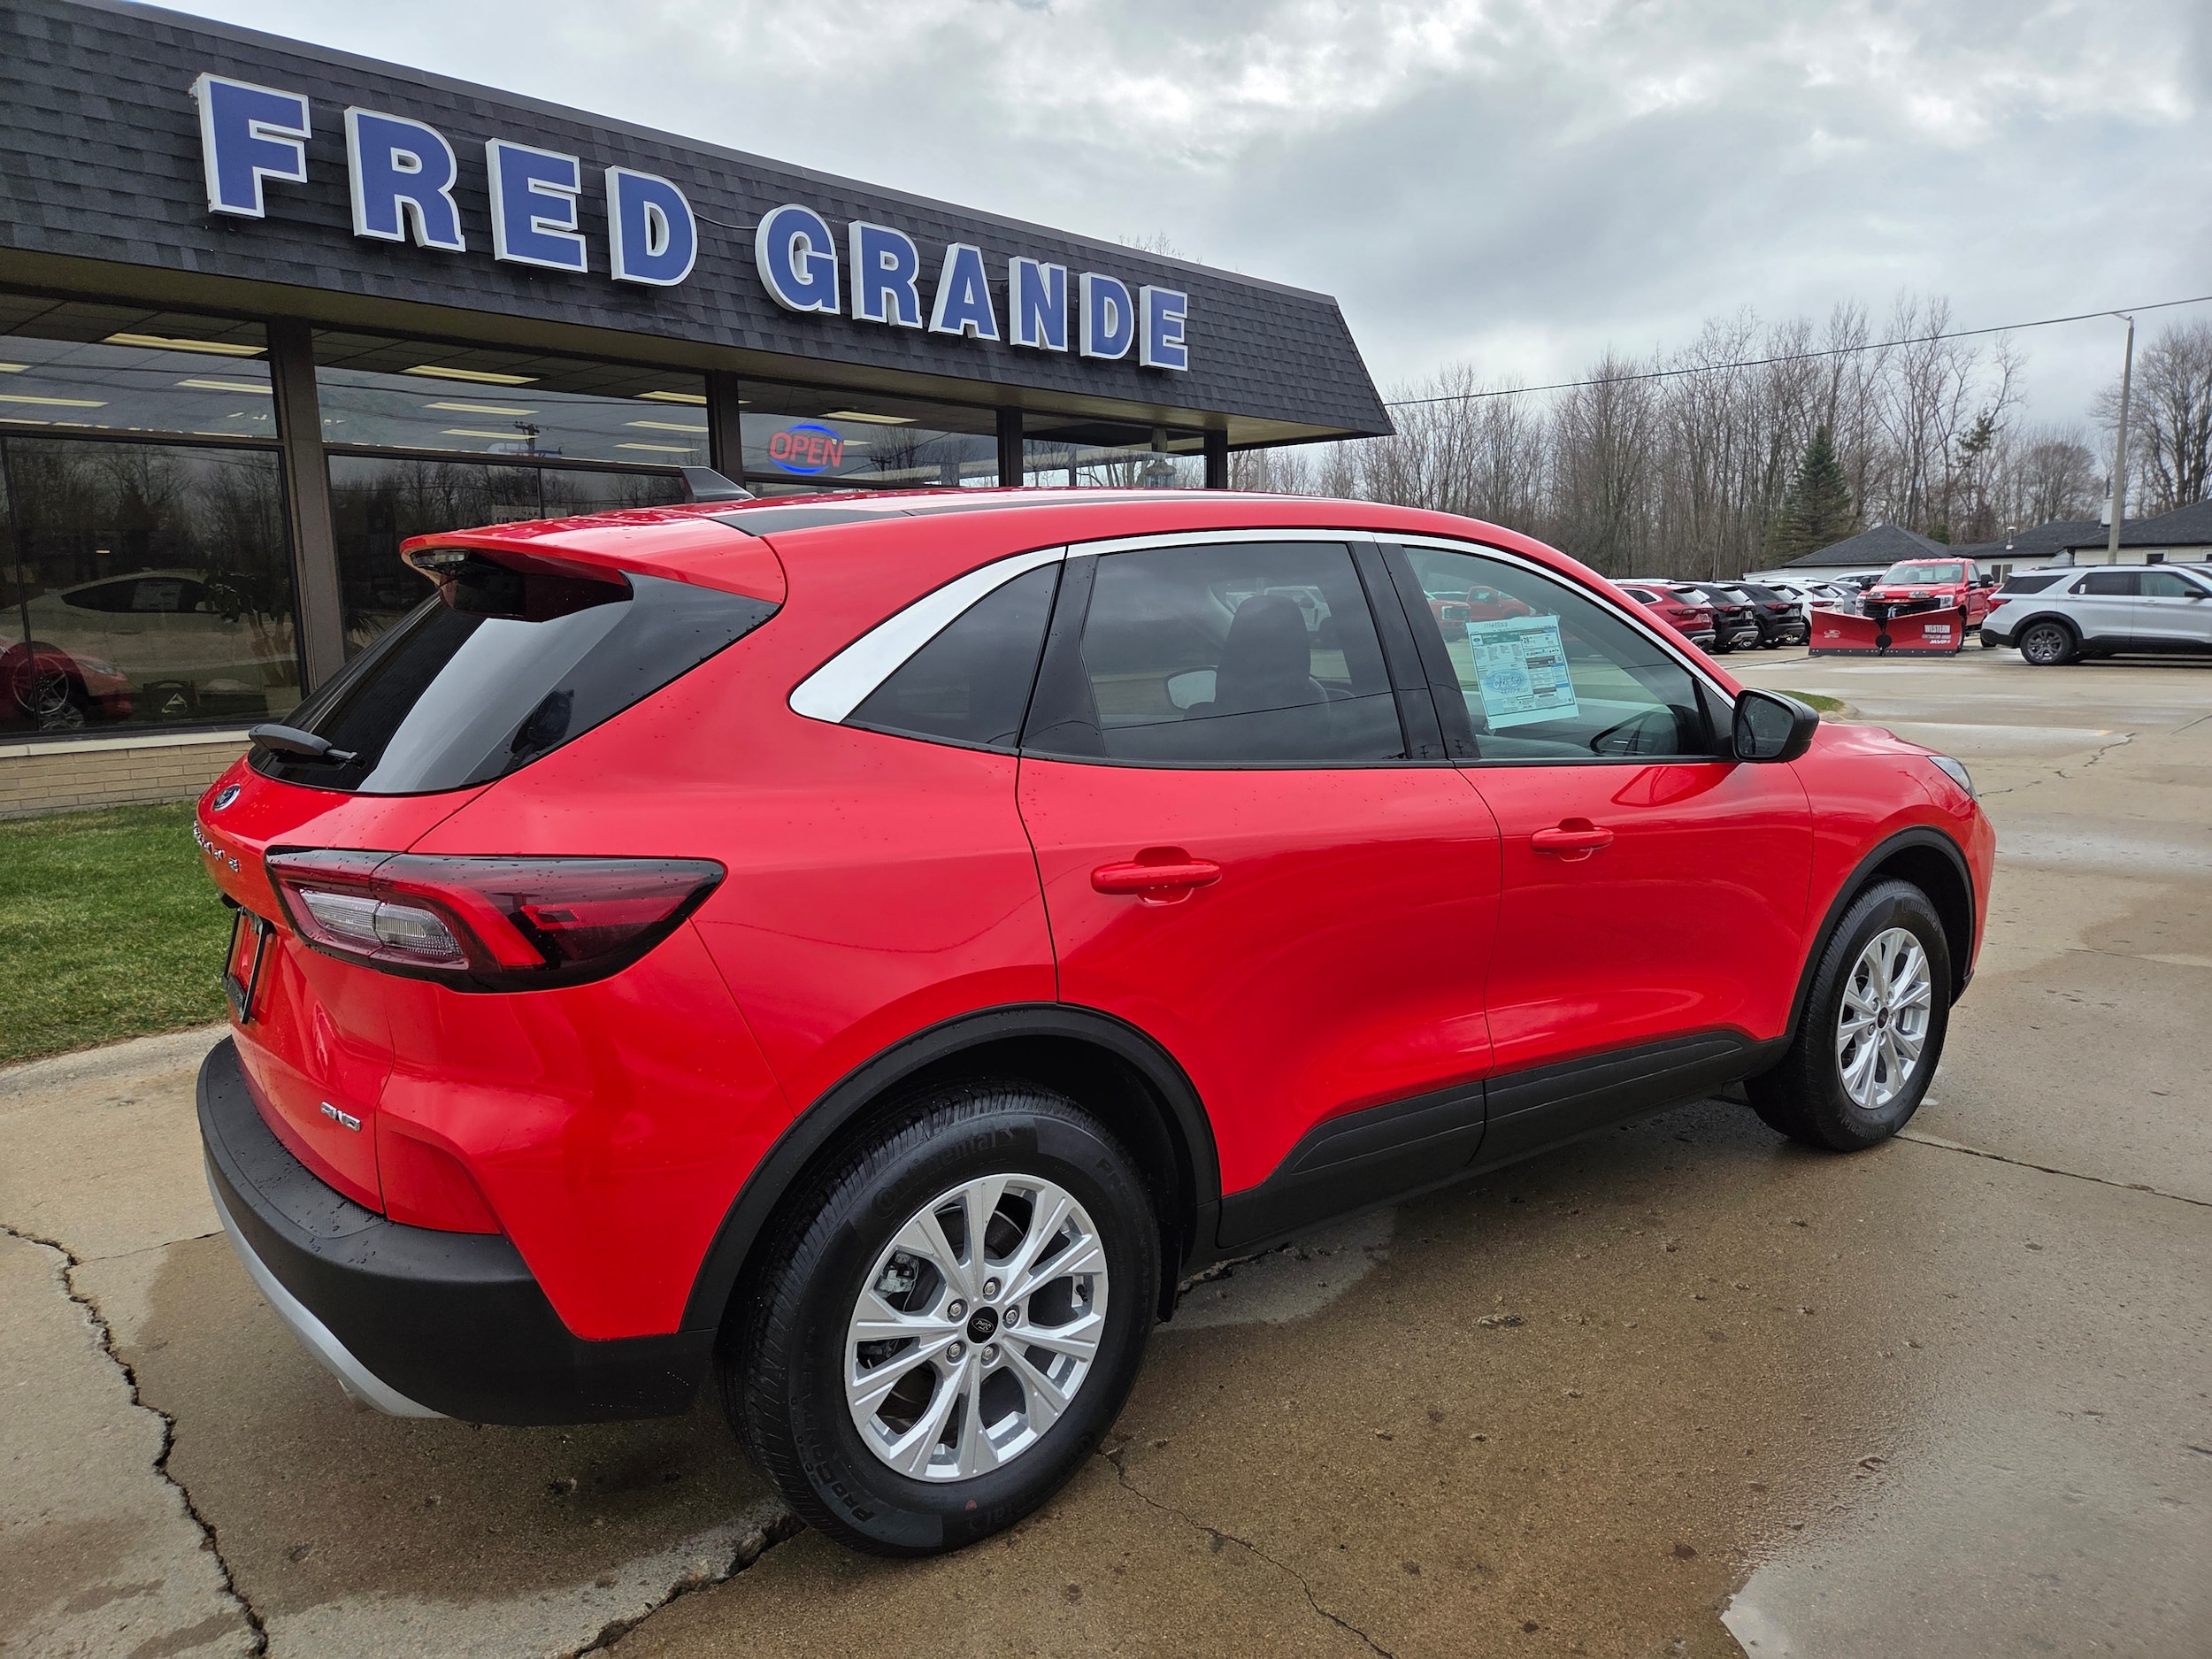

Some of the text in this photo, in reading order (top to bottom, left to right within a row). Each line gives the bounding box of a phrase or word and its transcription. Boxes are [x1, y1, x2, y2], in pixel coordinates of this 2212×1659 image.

[197, 73, 1188, 372] FRED GRANDE
[770, 432, 844, 467] OPEN
[320, 1101, 362, 1133] AWD
